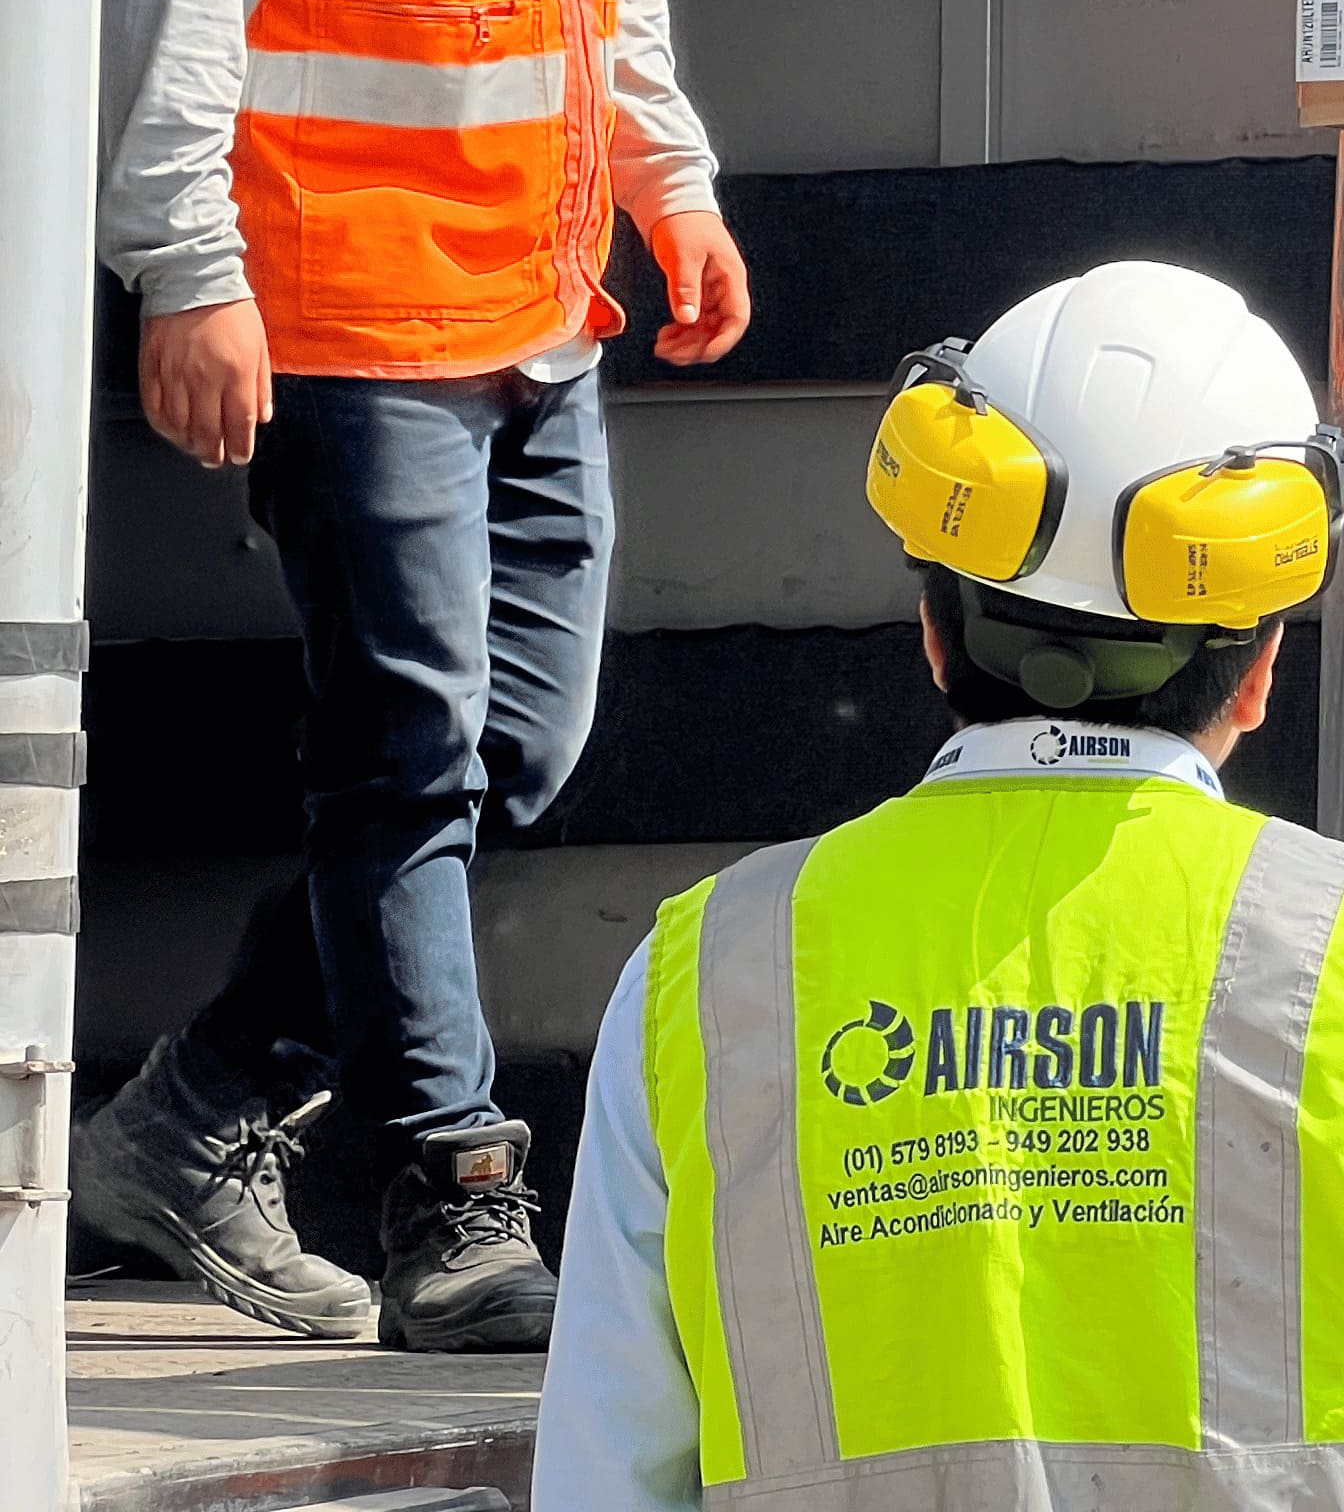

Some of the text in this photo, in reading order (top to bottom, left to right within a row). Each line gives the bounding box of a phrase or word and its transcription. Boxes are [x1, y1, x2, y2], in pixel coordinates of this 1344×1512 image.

[1069, 736, 1130, 757] AIRSON
[924, 1001, 1165, 1096] AIRSON
[990, 1094, 1165, 1122] INGENIEROS
[843, 1144, 883, 1178] (01)
[891, 1137, 930, 1166] 579
[935, 1129, 979, 1157] 8193
[1007, 1131, 1050, 1153] 949
[1058, 1130, 1099, 1153] 202
[1107, 1128, 1149, 1152] 938
[828, 1164, 1167, 1210] ventas@airsoningenieros.com
[820, 1196, 1185, 1249] Aire Acondicionado y Ventilación
